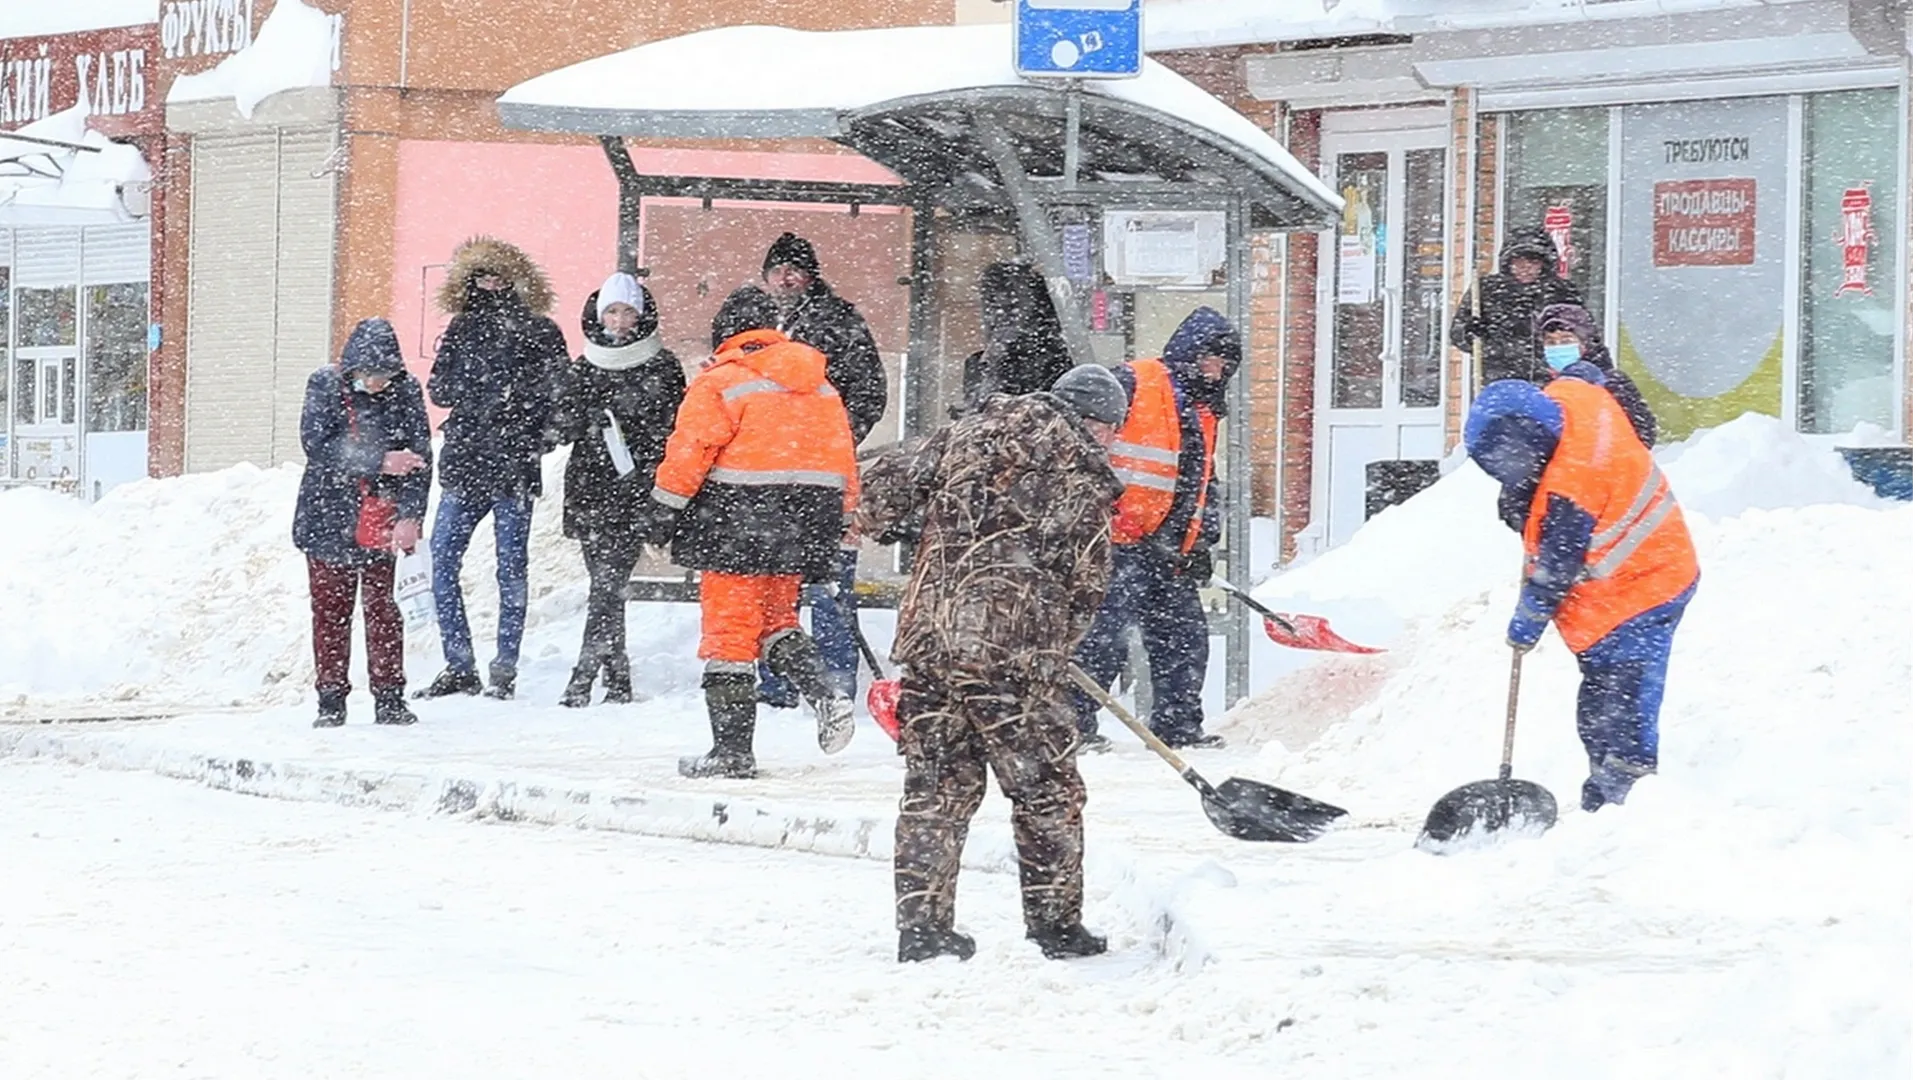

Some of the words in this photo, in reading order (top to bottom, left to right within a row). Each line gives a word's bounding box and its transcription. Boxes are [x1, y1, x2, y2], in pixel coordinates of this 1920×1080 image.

[162, 0, 252, 59] ФРУКТЫ
[76, 49, 145, 115] ХЛЕБ
[1664, 137, 1749, 162] ТРЕБУЮТСЯ
[1668, 228, 1741, 252] КАССИРЫ
